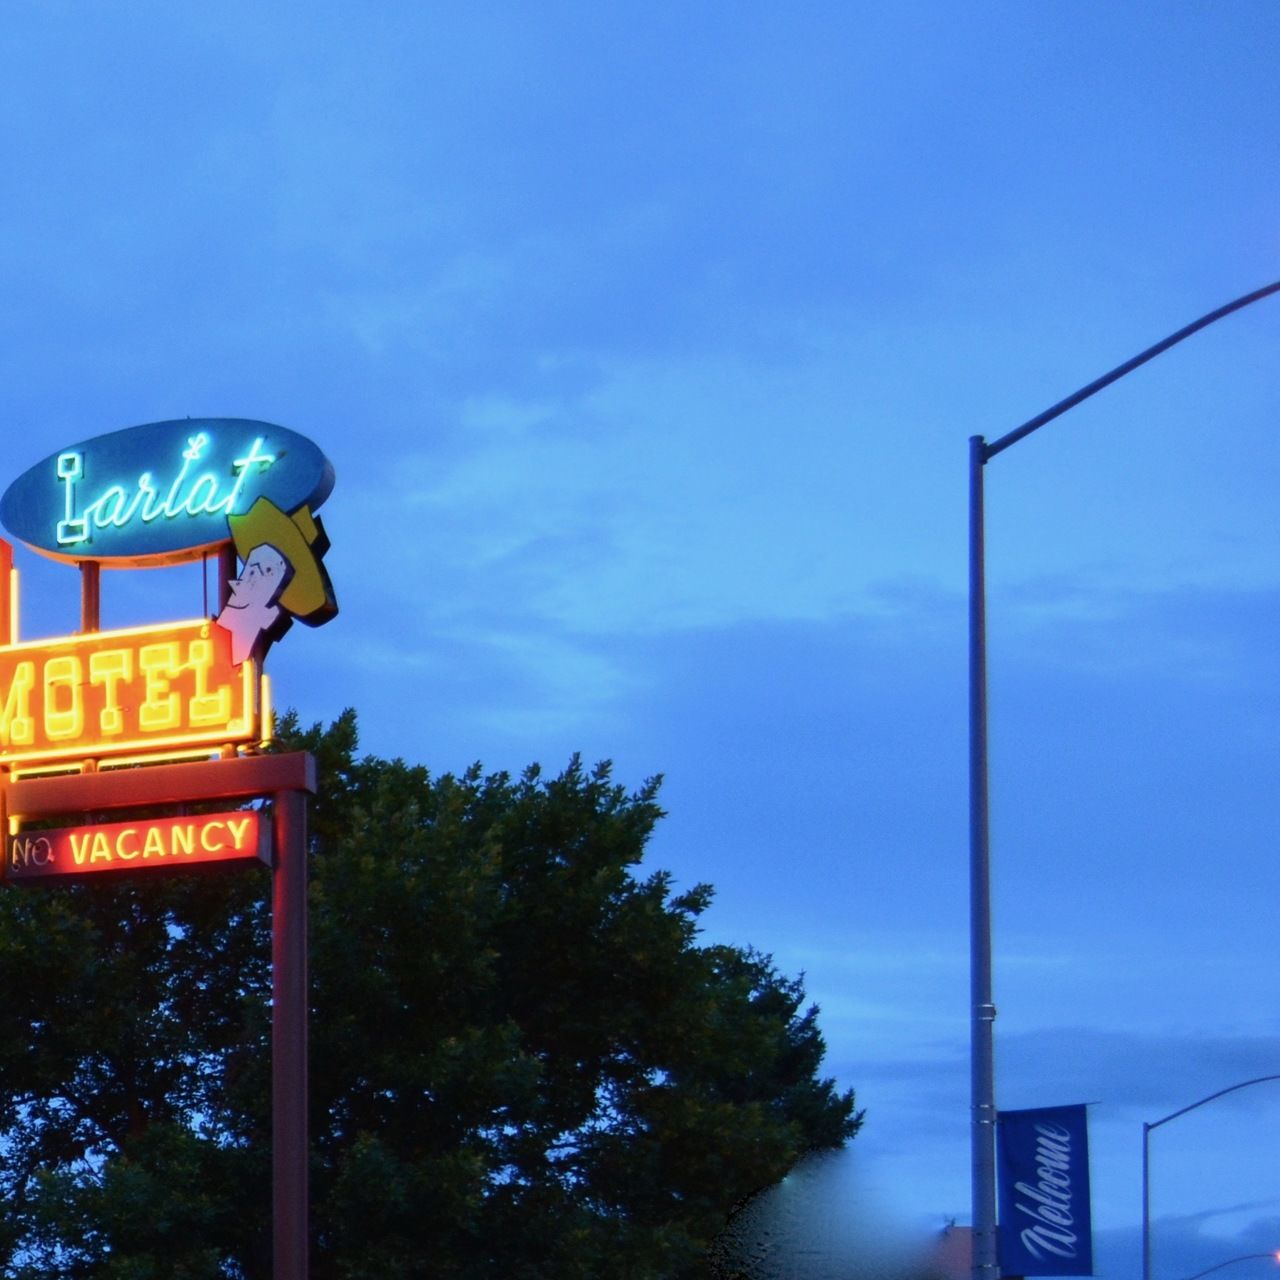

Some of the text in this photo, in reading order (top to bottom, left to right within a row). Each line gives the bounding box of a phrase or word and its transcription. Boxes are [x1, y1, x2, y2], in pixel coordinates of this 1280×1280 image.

[56, 432, 277, 545] Lariat
[11, 818, 251, 868] NO VACANCY
[1012, 1119, 1079, 1264] Welcome
